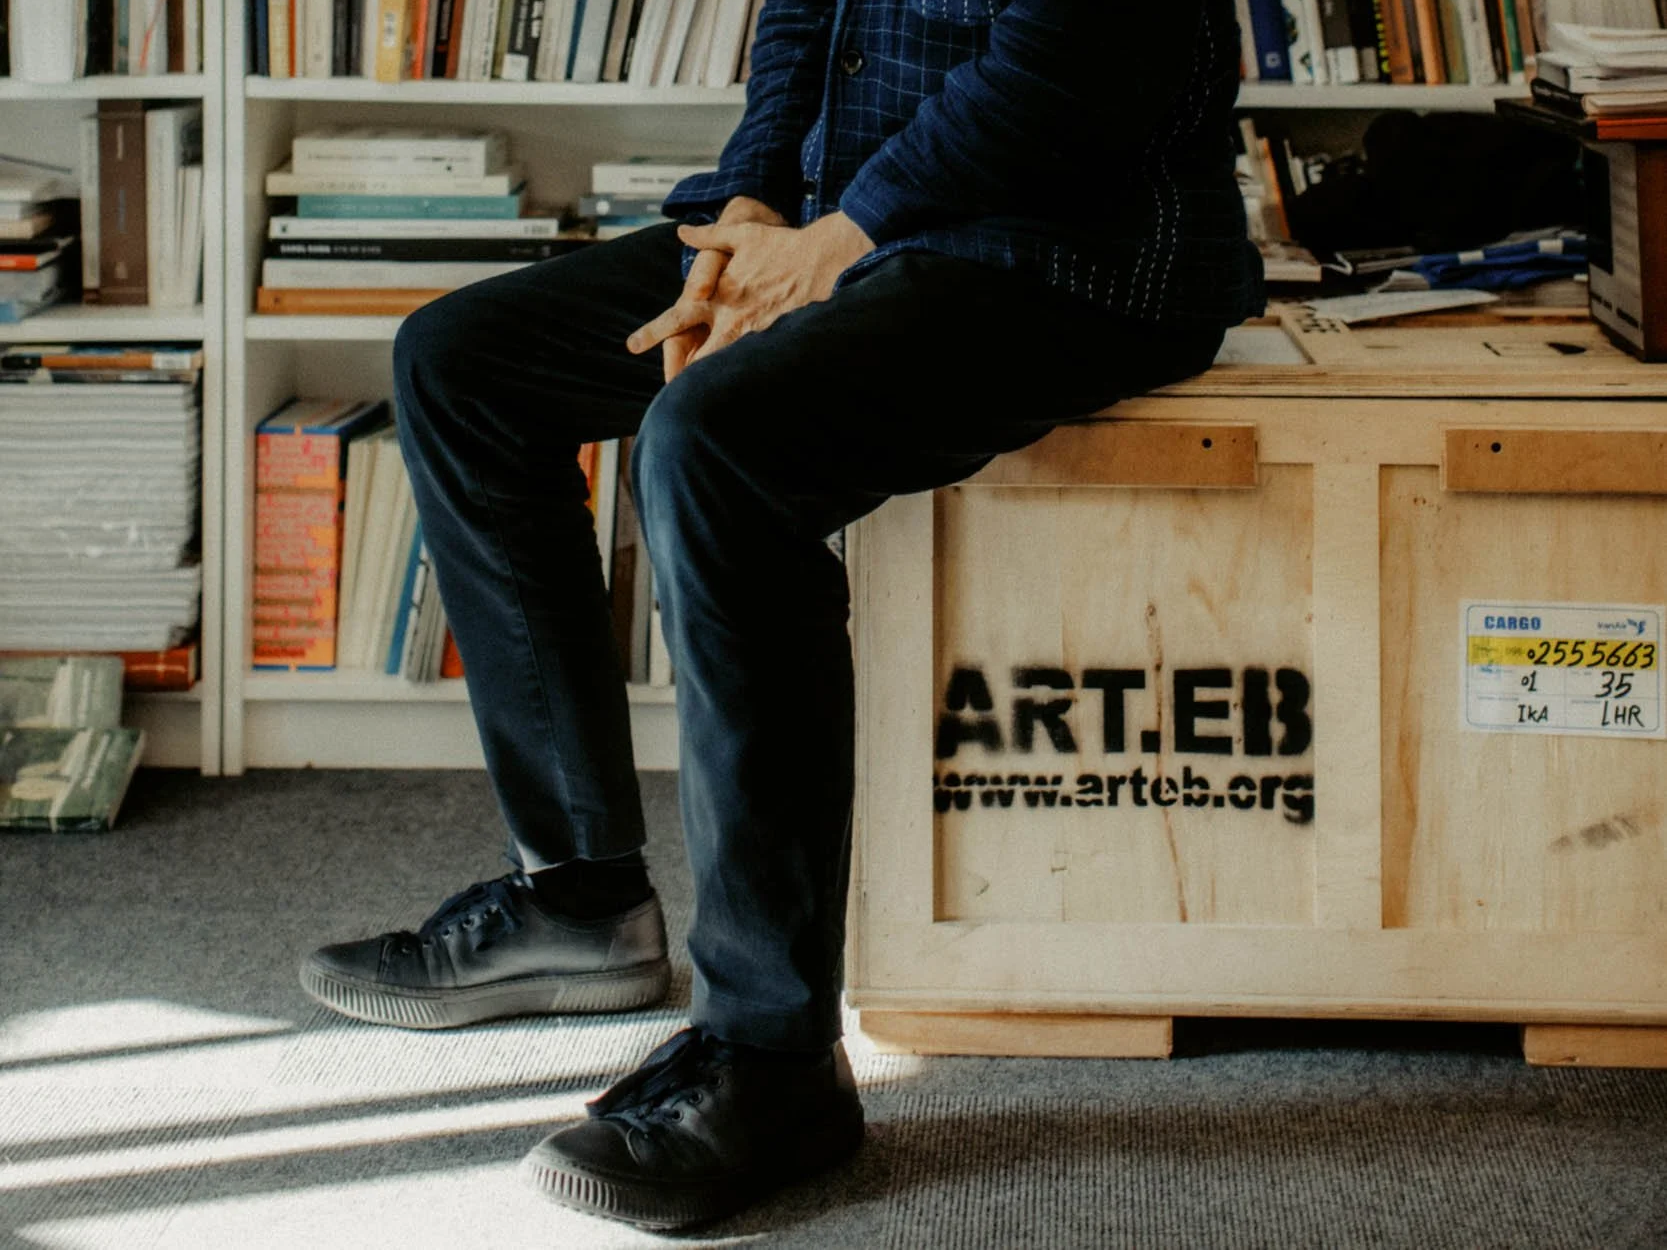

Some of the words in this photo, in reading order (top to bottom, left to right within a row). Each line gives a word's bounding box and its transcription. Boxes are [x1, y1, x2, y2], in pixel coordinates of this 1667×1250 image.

[1483, 616, 1541, 631] CARGO
[1595, 670, 1635, 699] 35
[934, 665, 1313, 759] ART.EB
[934, 766, 1315, 827] www.arteb.org
